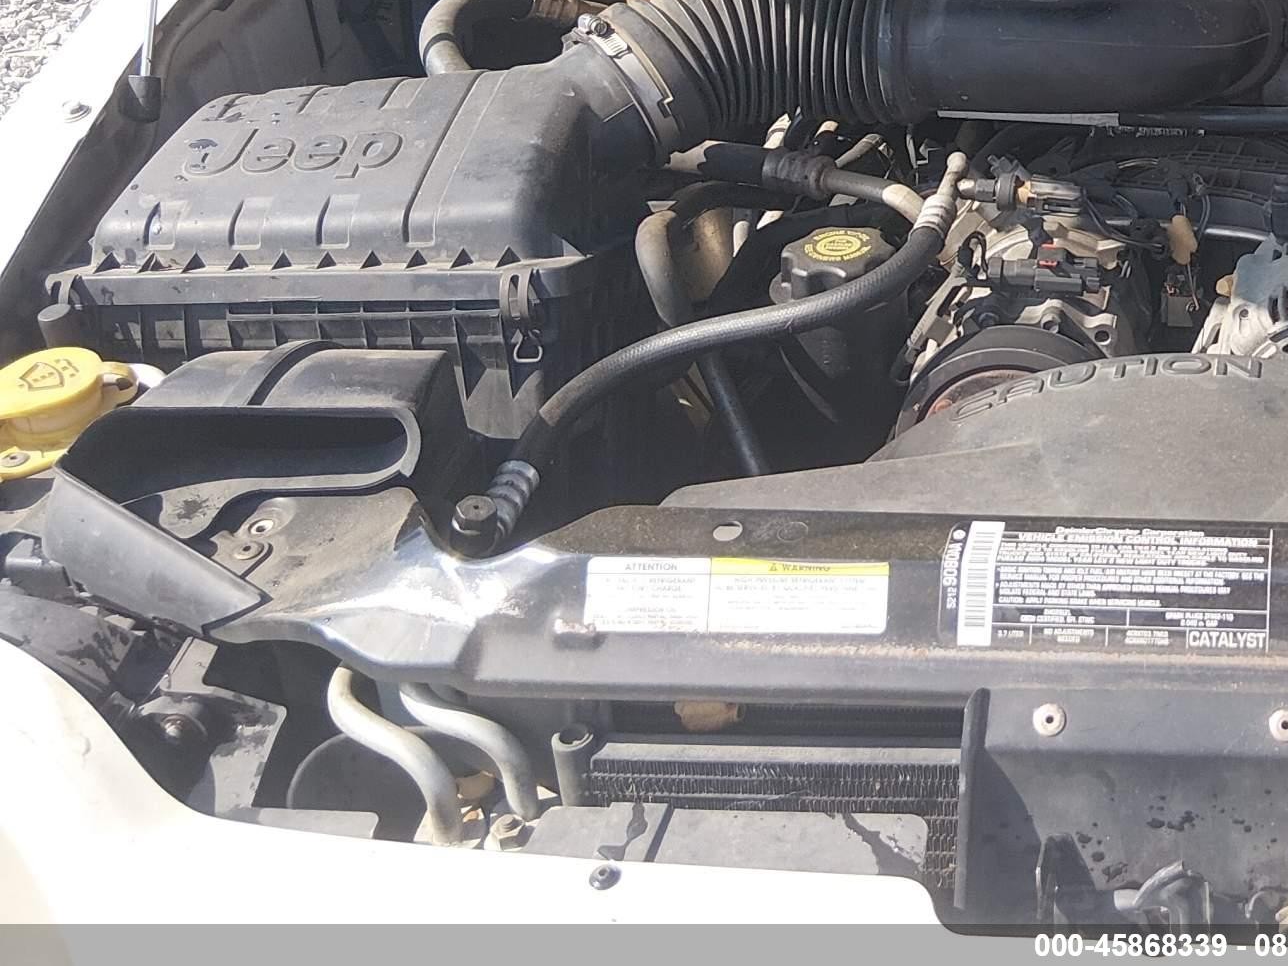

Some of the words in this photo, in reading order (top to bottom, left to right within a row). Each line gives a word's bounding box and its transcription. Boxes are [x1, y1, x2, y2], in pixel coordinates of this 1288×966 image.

[183, 128, 404, 180] Jeep
[949, 353, 1263, 423] CAUTION
[624, 563, 678, 571] ATTENTION
[1188, 630, 1266, 649] CATALYST
